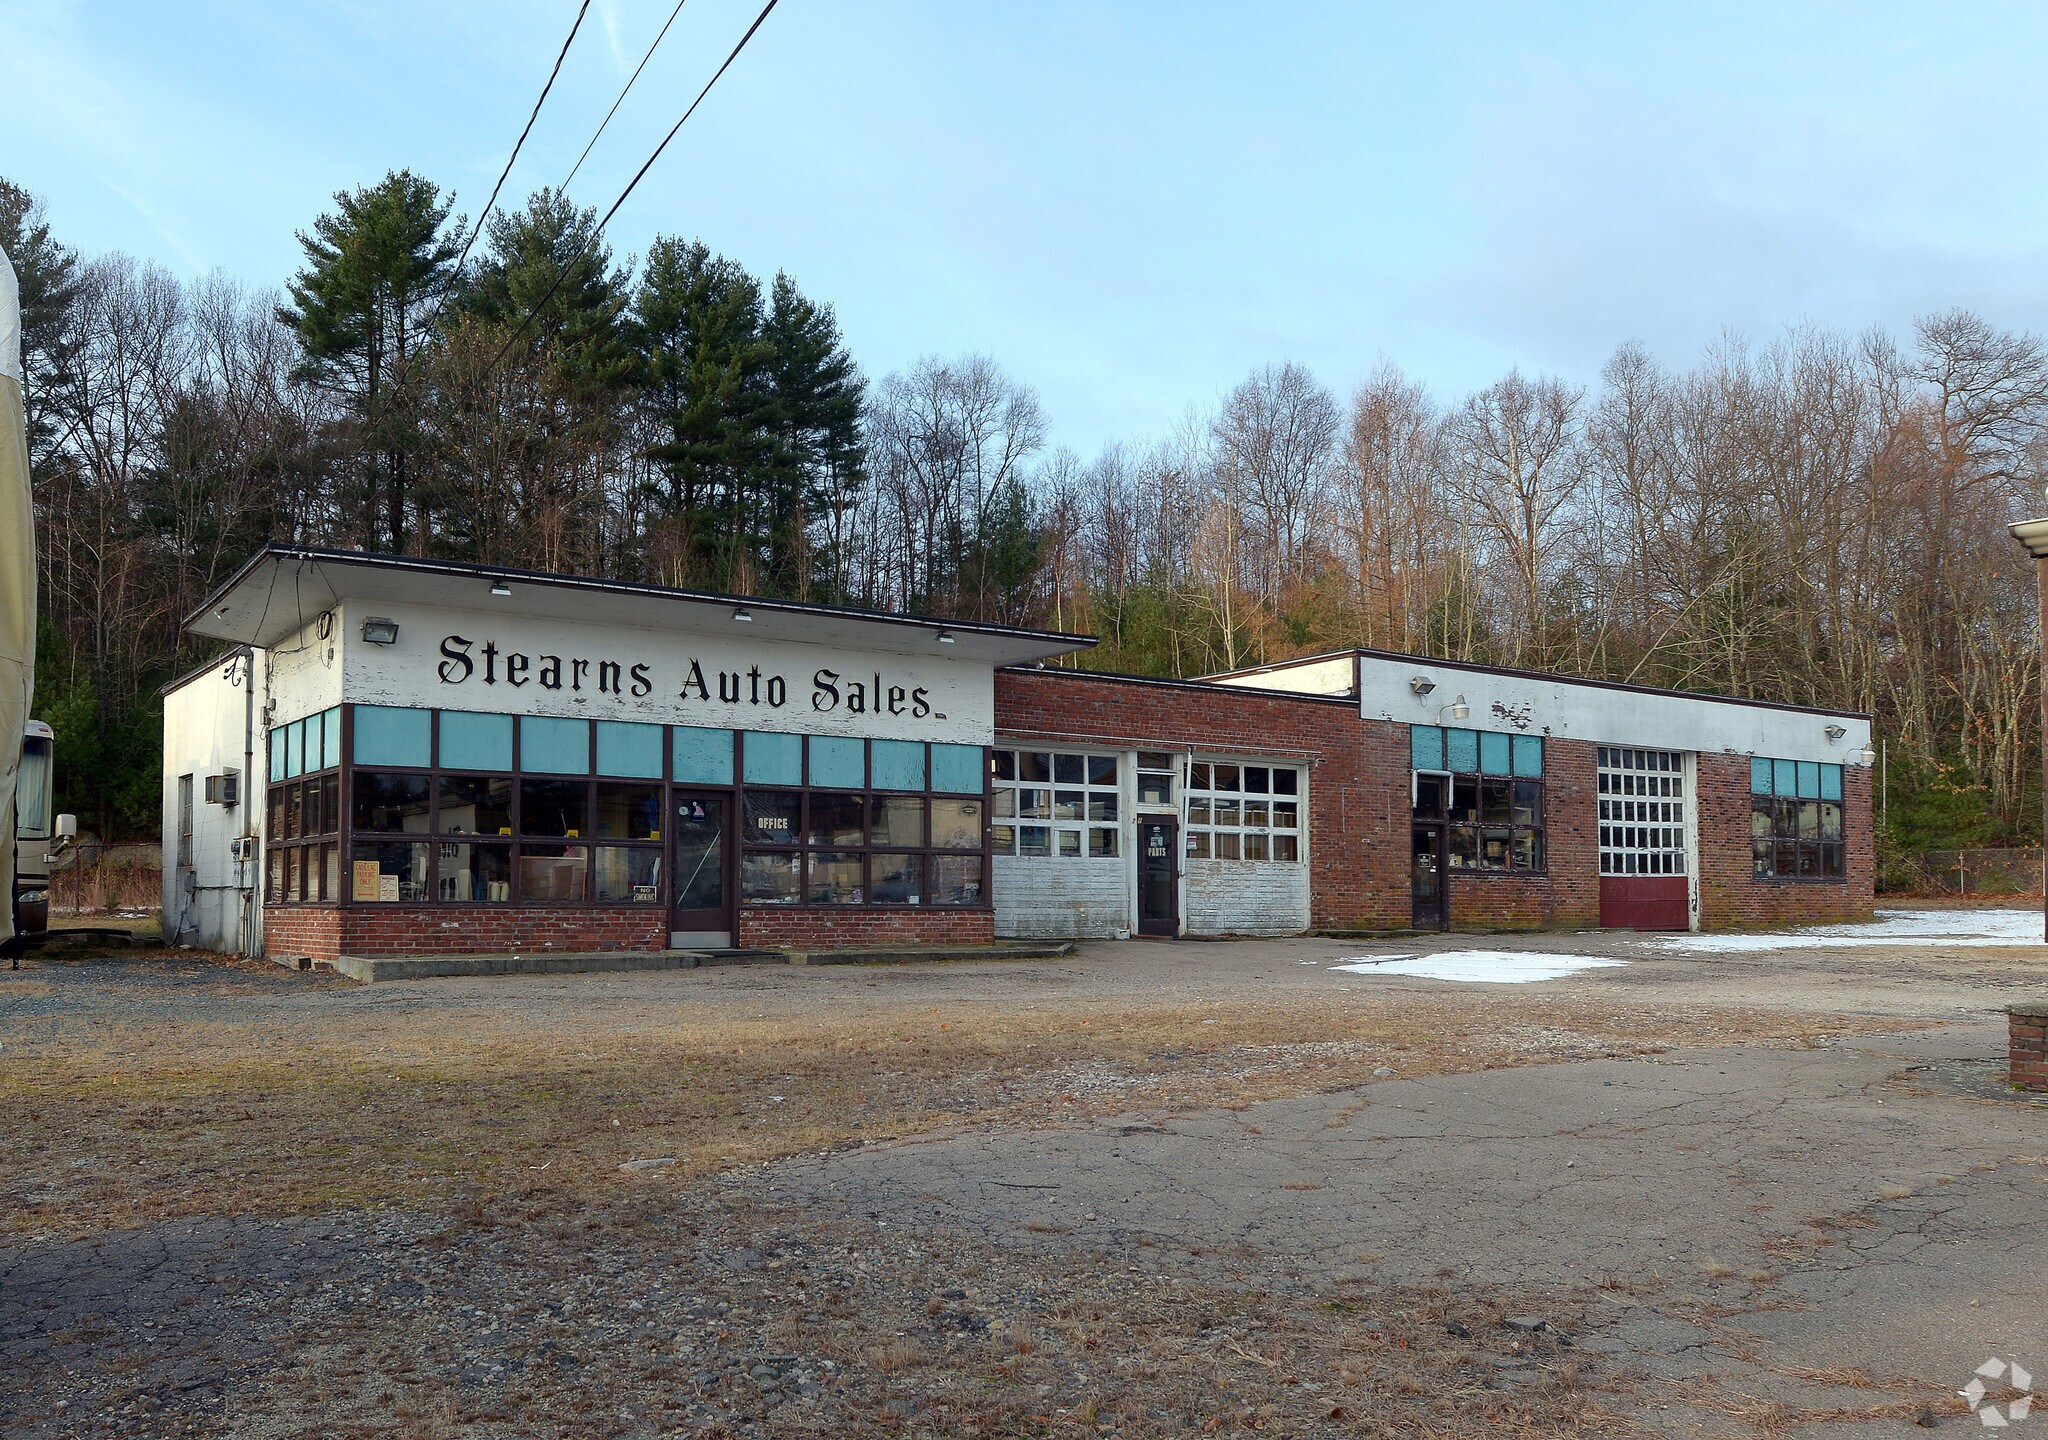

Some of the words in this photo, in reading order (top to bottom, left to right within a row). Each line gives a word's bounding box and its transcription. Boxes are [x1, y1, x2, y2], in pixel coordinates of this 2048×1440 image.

[437, 634, 653, 697] Stearns
[678, 656, 786, 708] Auto
[811, 668, 930, 719] Sales
[757, 817, 788, 829] OFFICE
[1148, 847, 1167, 857] PARTS
[360, 878, 372, 886] ONLY
